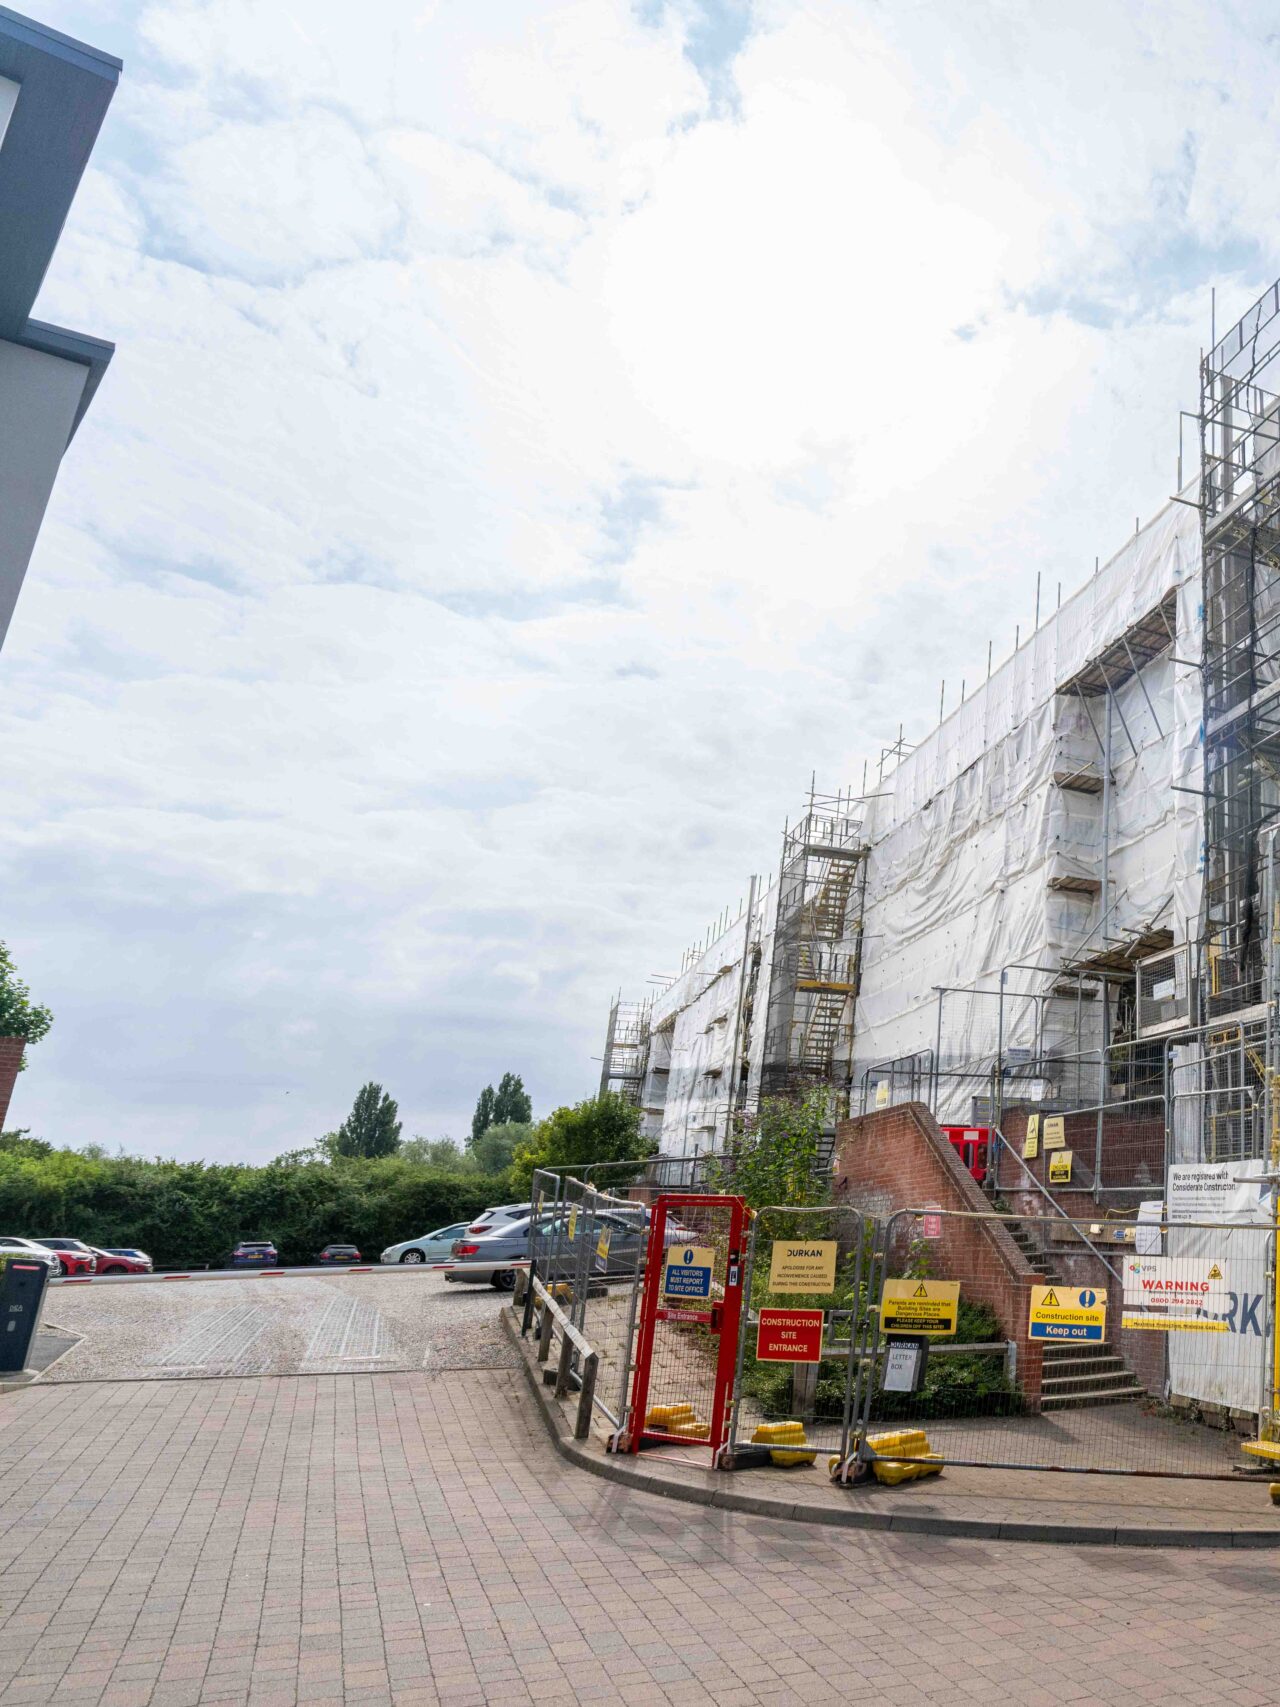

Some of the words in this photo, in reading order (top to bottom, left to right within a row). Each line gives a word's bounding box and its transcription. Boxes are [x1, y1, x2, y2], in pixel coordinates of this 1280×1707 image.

[1192, 1172, 1215, 1182] registered
[1173, 1183, 1203, 1191] Considerate
[1142, 1280, 1210, 1292] WARNING
[1036, 1312, 1083, 1320] Construction
[761, 1318, 820, 1327] CONSTRUCTION
[1046, 1325, 1069, 1336] Keep
[1072, 1328, 1087, 1336] out
[781, 1331, 797, 1339] SITE
[769, 1343, 808, 1352] ENTRANCE
[893, 1353, 912, 1361] LETTER
[891, 1362, 903, 1370] BOX
